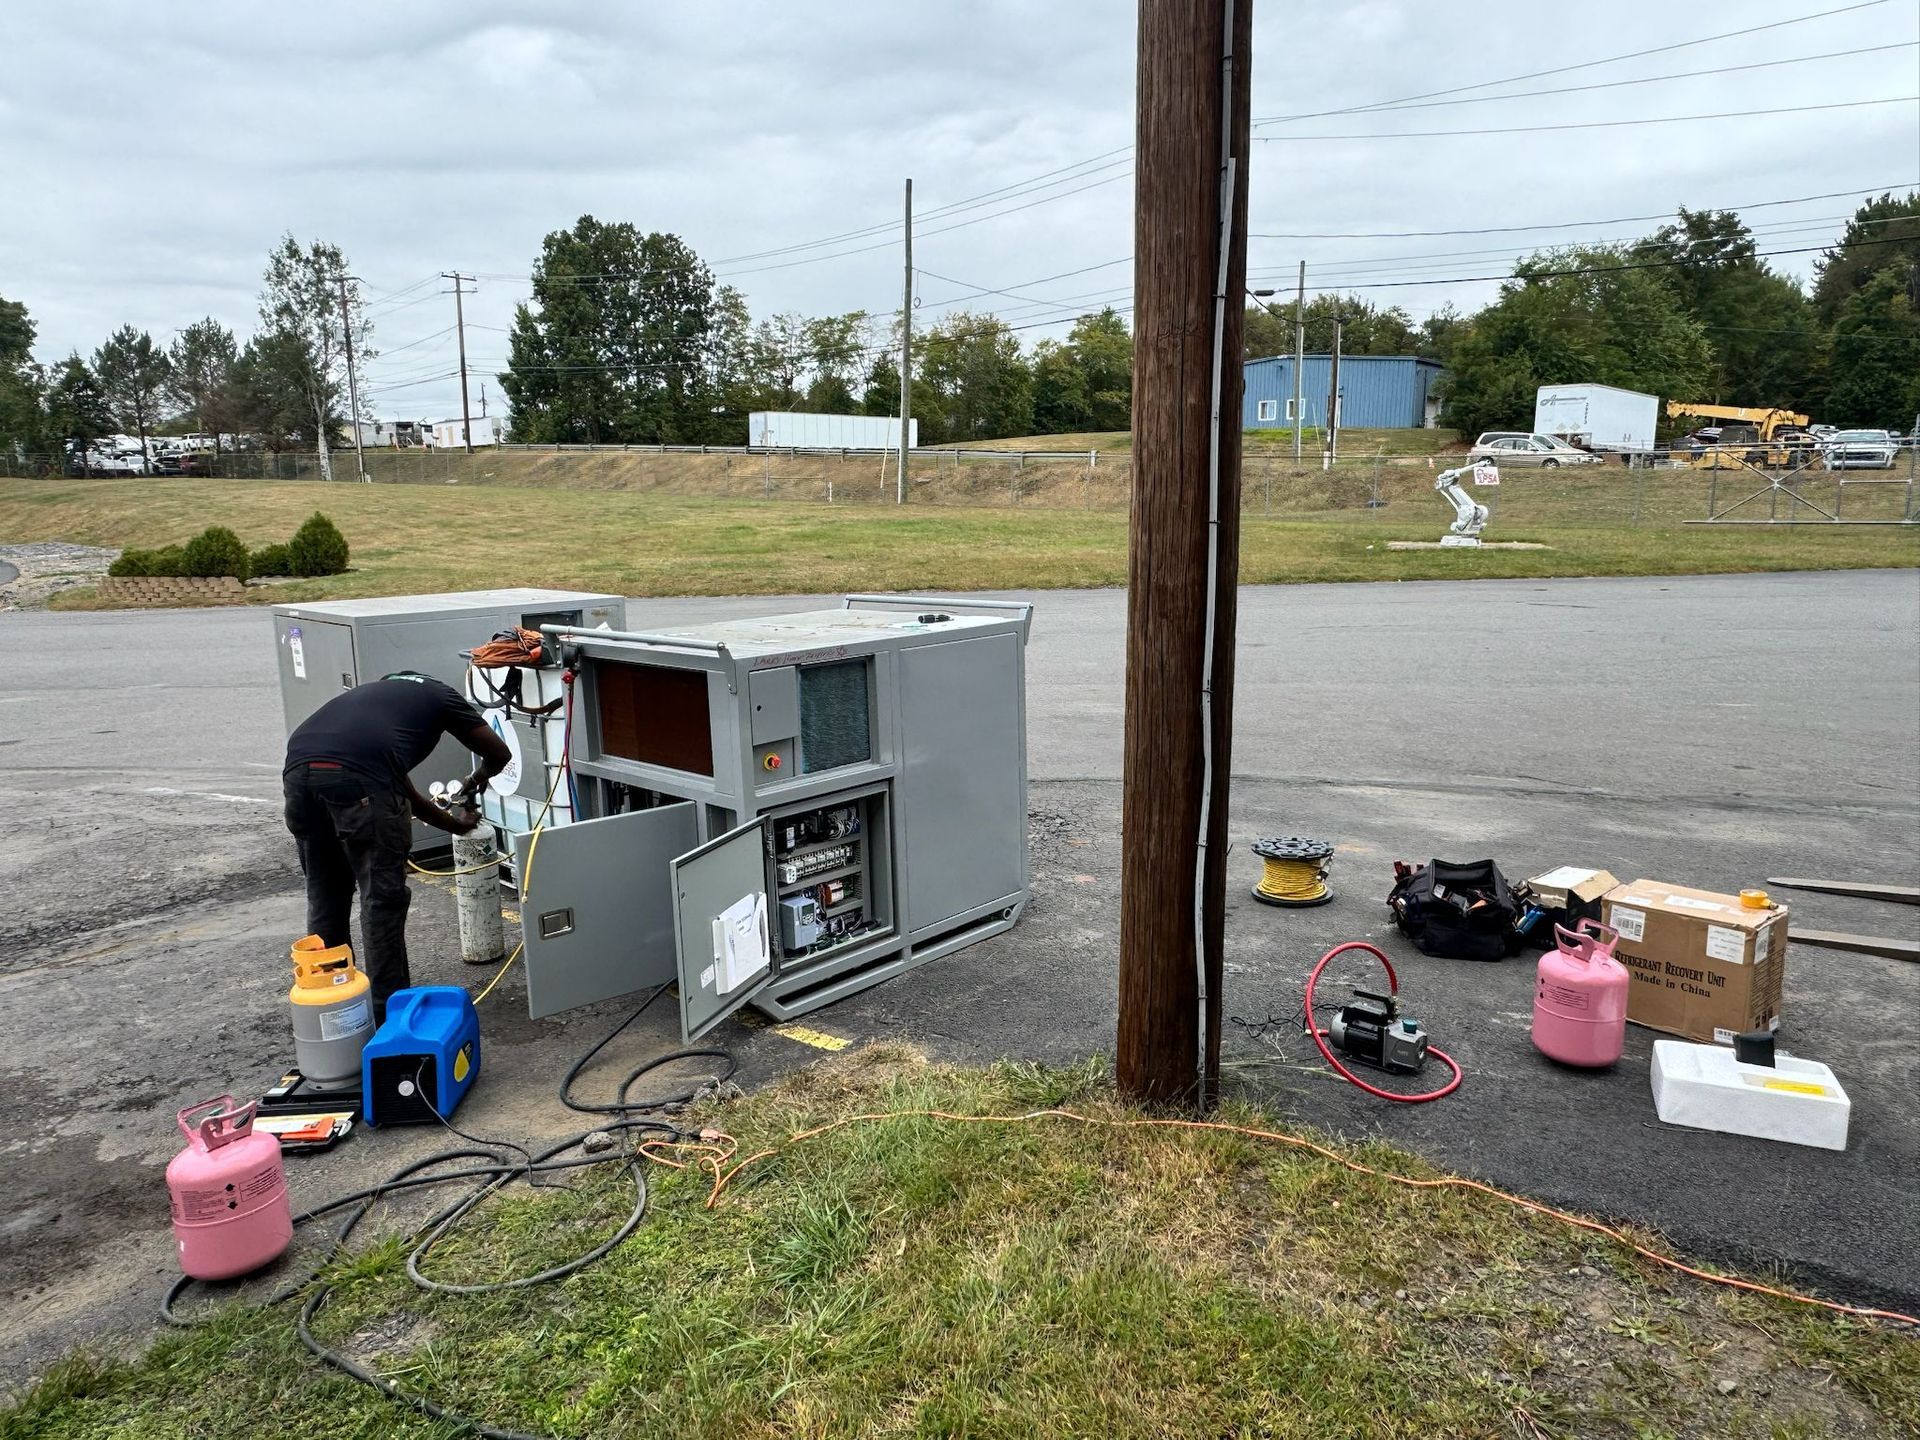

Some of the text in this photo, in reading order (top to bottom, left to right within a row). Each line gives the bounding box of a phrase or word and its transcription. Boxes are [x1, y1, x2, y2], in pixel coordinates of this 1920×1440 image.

[1634, 971, 1661, 986] Made
[1680, 982, 1711, 998] China
[1665, 961, 1704, 983] RECOVERY
[1707, 971, 1727, 988] UNIT
